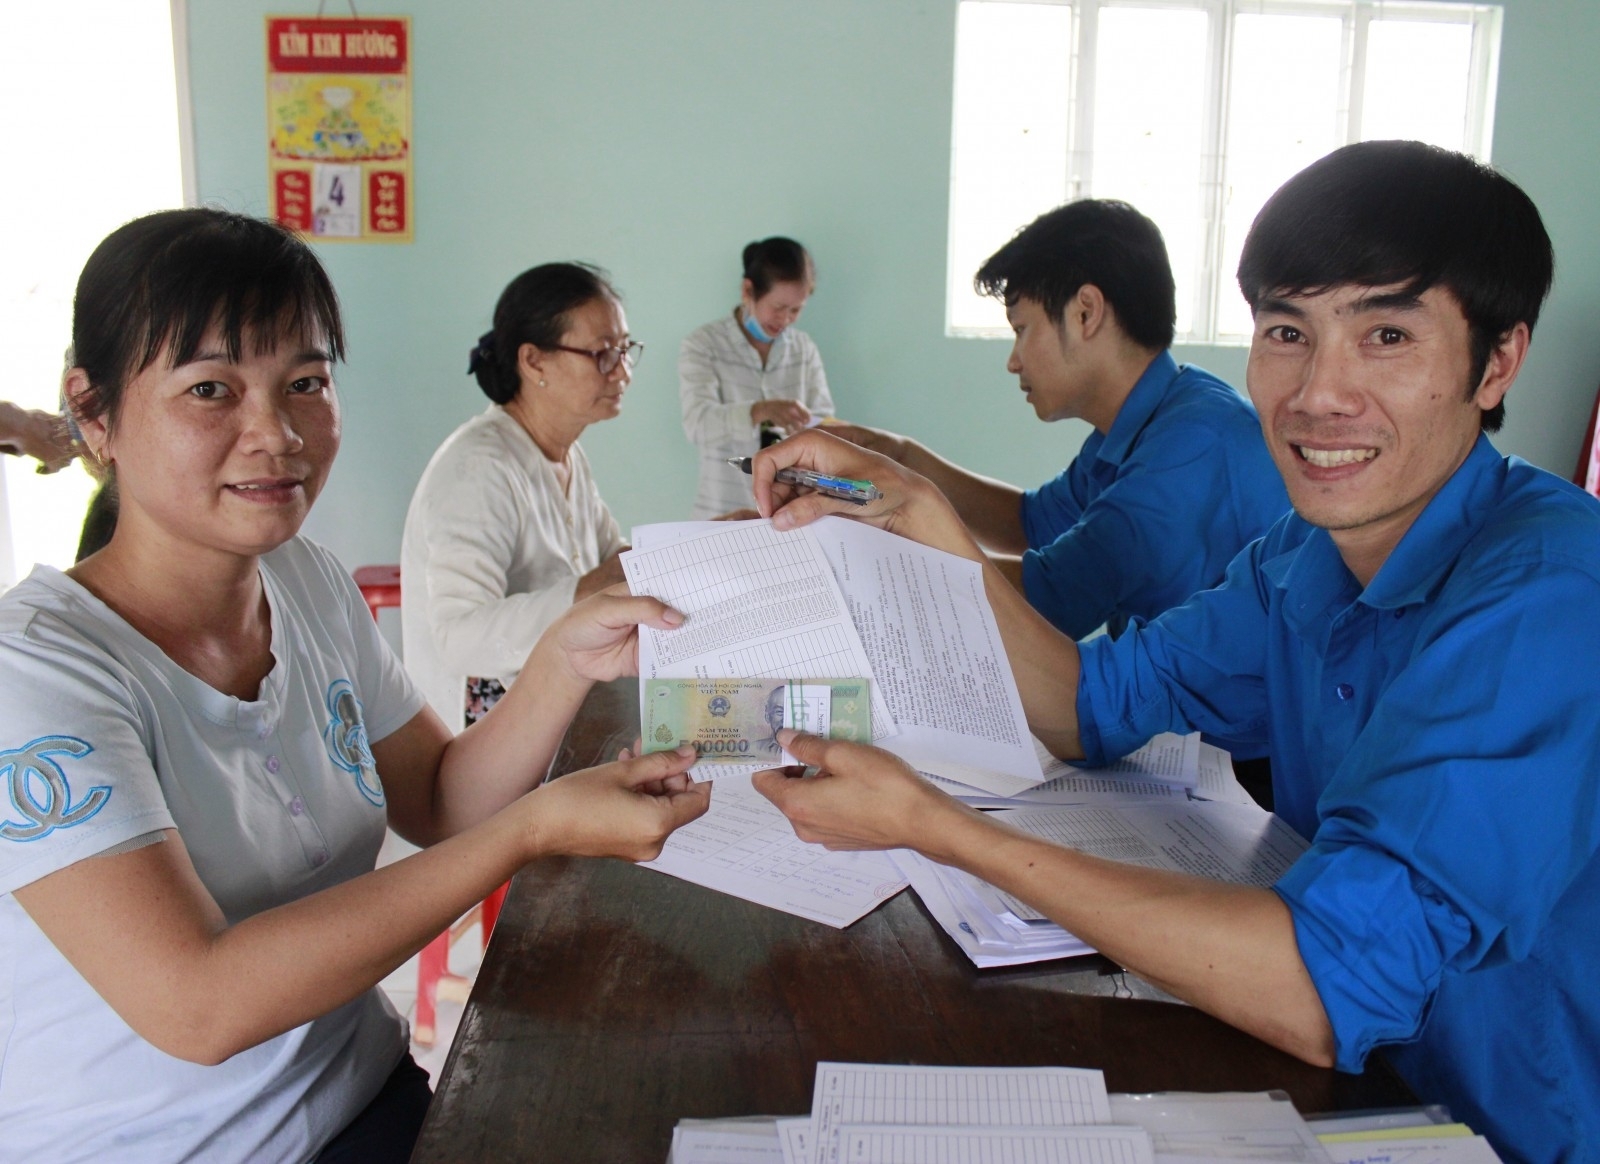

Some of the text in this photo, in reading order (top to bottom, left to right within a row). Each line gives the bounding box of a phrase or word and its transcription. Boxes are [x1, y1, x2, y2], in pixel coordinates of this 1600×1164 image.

[312, 33, 342, 57] KIM
[328, 175, 345, 207] 4
[680, 739, 749, 753] 00000
